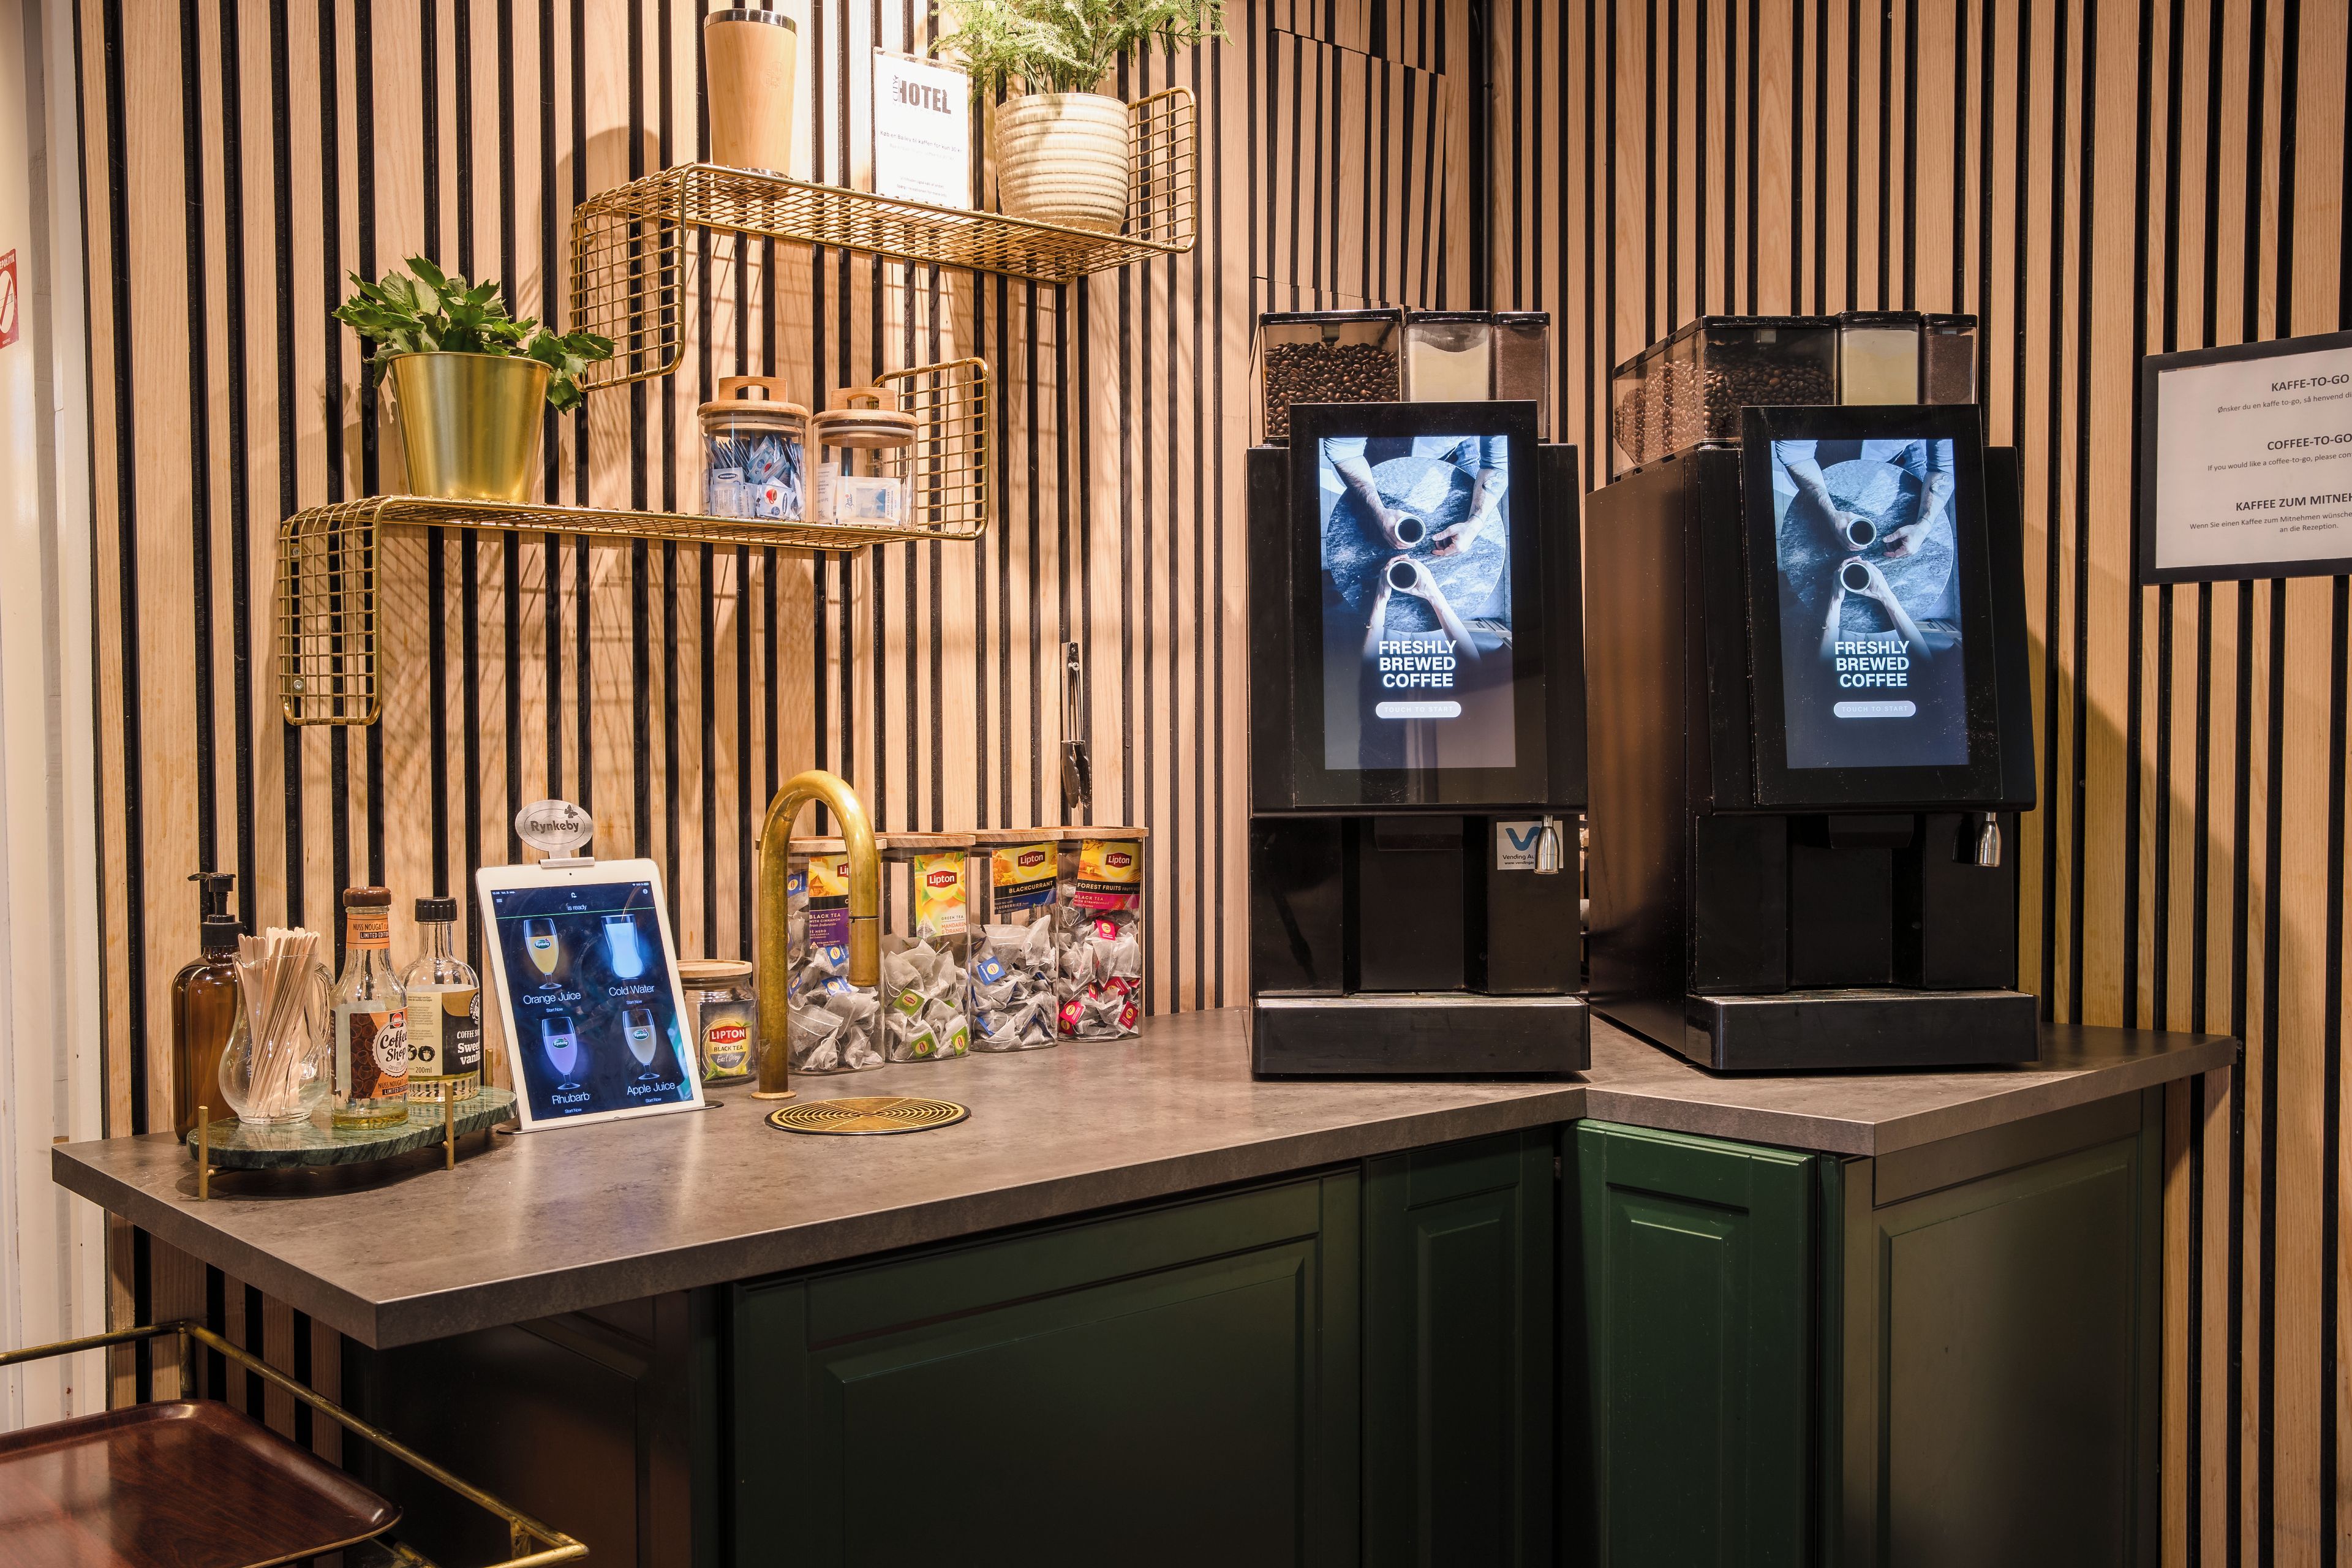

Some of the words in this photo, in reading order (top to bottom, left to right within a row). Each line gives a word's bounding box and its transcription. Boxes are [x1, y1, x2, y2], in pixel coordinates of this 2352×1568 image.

[900, 80, 951, 115] HOTEL
[2271, 374, 2350, 392] KAFFE-TO-GO
[2218, 405, 2241, 413] Ønsker
[2313, 393, 2343, 402] henvend
[2267, 433, 2352, 451] COFFEE-TO-GO
[2214, 463, 2226, 472] you
[2268, 456, 2313, 466] coffee-to-go,
[2236, 499, 2276, 511] KAFFEE
[2279, 496, 2306, 508] ZUM
[2280, 514, 2321, 522] Mitnehmen
[2302, 524, 2339, 532] Rezeption.
[1379, 640, 1457, 655] FRESHLY
[1834, 641, 1910, 655] FRESHLY
[1379, 657, 1456, 671] BREWED
[1836, 657, 1909, 671] BREWED
[1383, 673, 1453, 687] COFFEE
[1840, 673, 1907, 687] COFFEE
[530, 820, 579, 834] Rynkeby
[1020, 854, 1043, 865] Lipton
[1108, 856, 1130, 864] Lipton
[929, 875, 955, 885] Lipton
[1009, 881, 1053, 894] BLACKCURRANT
[609, 986, 629, 997] Cold
[630, 984, 655, 994] Water
[523, 995, 556, 1005] Orange
[558, 991, 581, 1001] Juice
[380, 1030, 407, 1049] Coffee
[457, 1030, 474, 1039] COFFEE
[711, 1029, 745, 1040] LIPTON
[386, 1047, 406, 1062] Shop
[717, 1054, 728, 1063] Earl
[729, 1054, 742, 1063] Grey
[627, 1084, 651, 1096] Apple
[653, 1082, 676, 1091] Juice
[552, 1091, 590, 1105] Rhubarb
